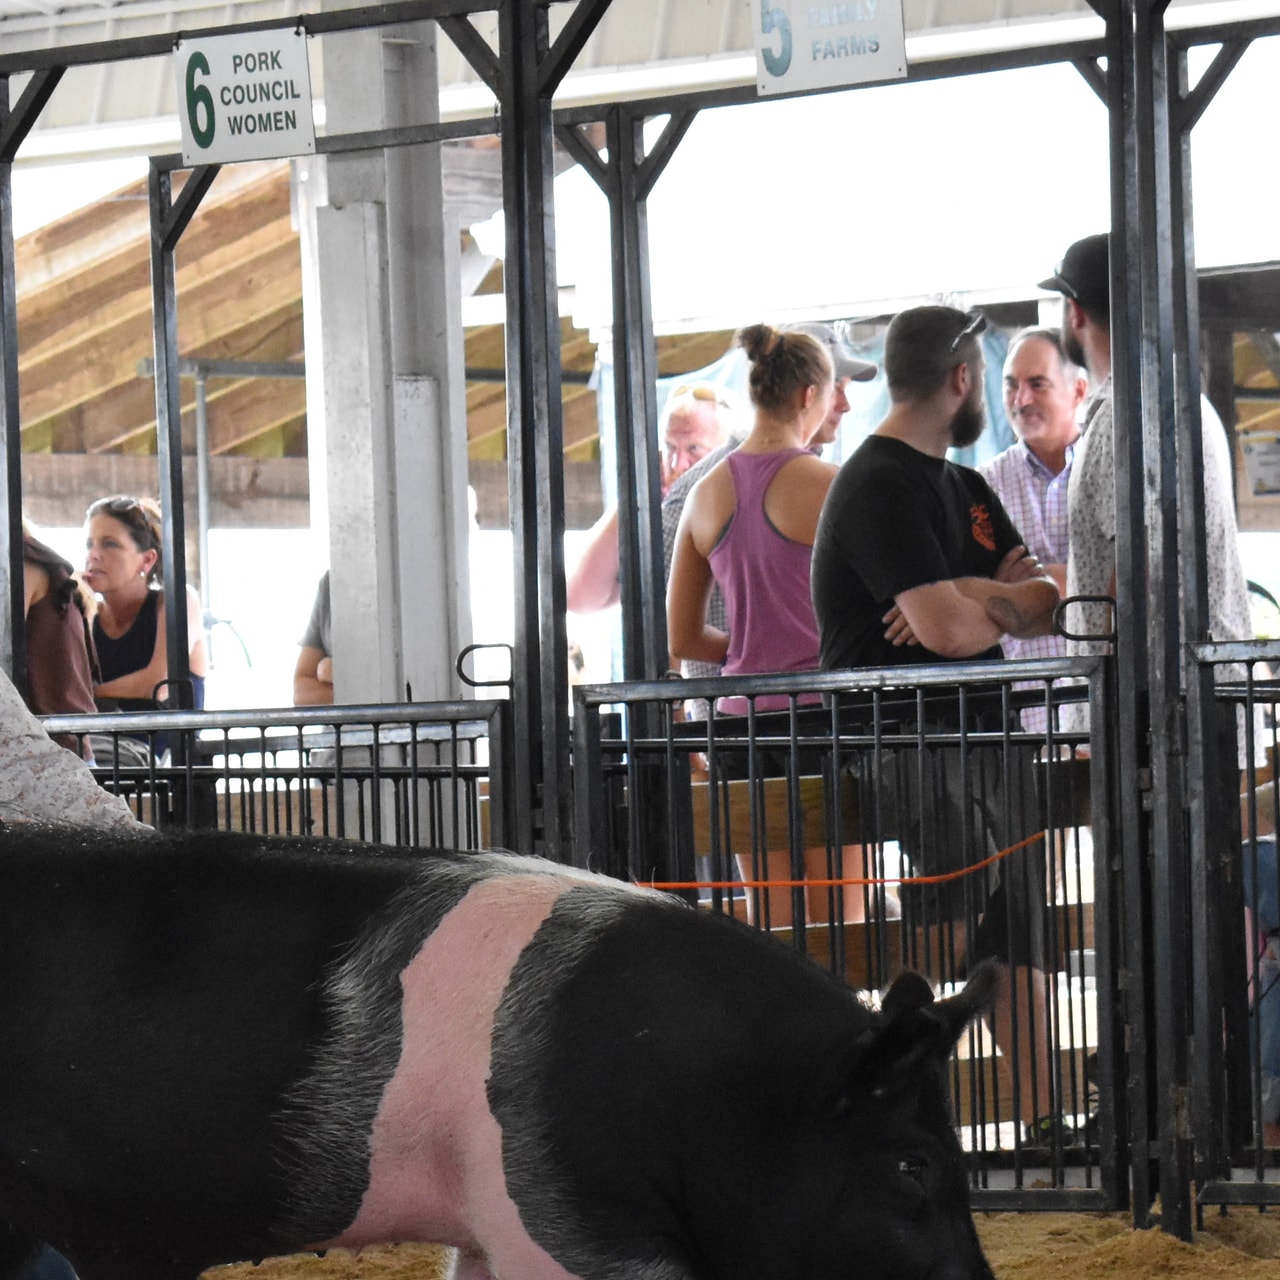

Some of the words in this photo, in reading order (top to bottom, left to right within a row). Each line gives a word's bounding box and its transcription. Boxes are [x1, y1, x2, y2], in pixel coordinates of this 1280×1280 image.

[760, 0, 792, 77] 5
[811, 34, 880, 61] FARMS
[232, 49, 283, 75] PORK
[185, 51, 216, 149] 6
[220, 79, 301, 106] COUNCIL
[227, 109, 297, 136] WOMEN
